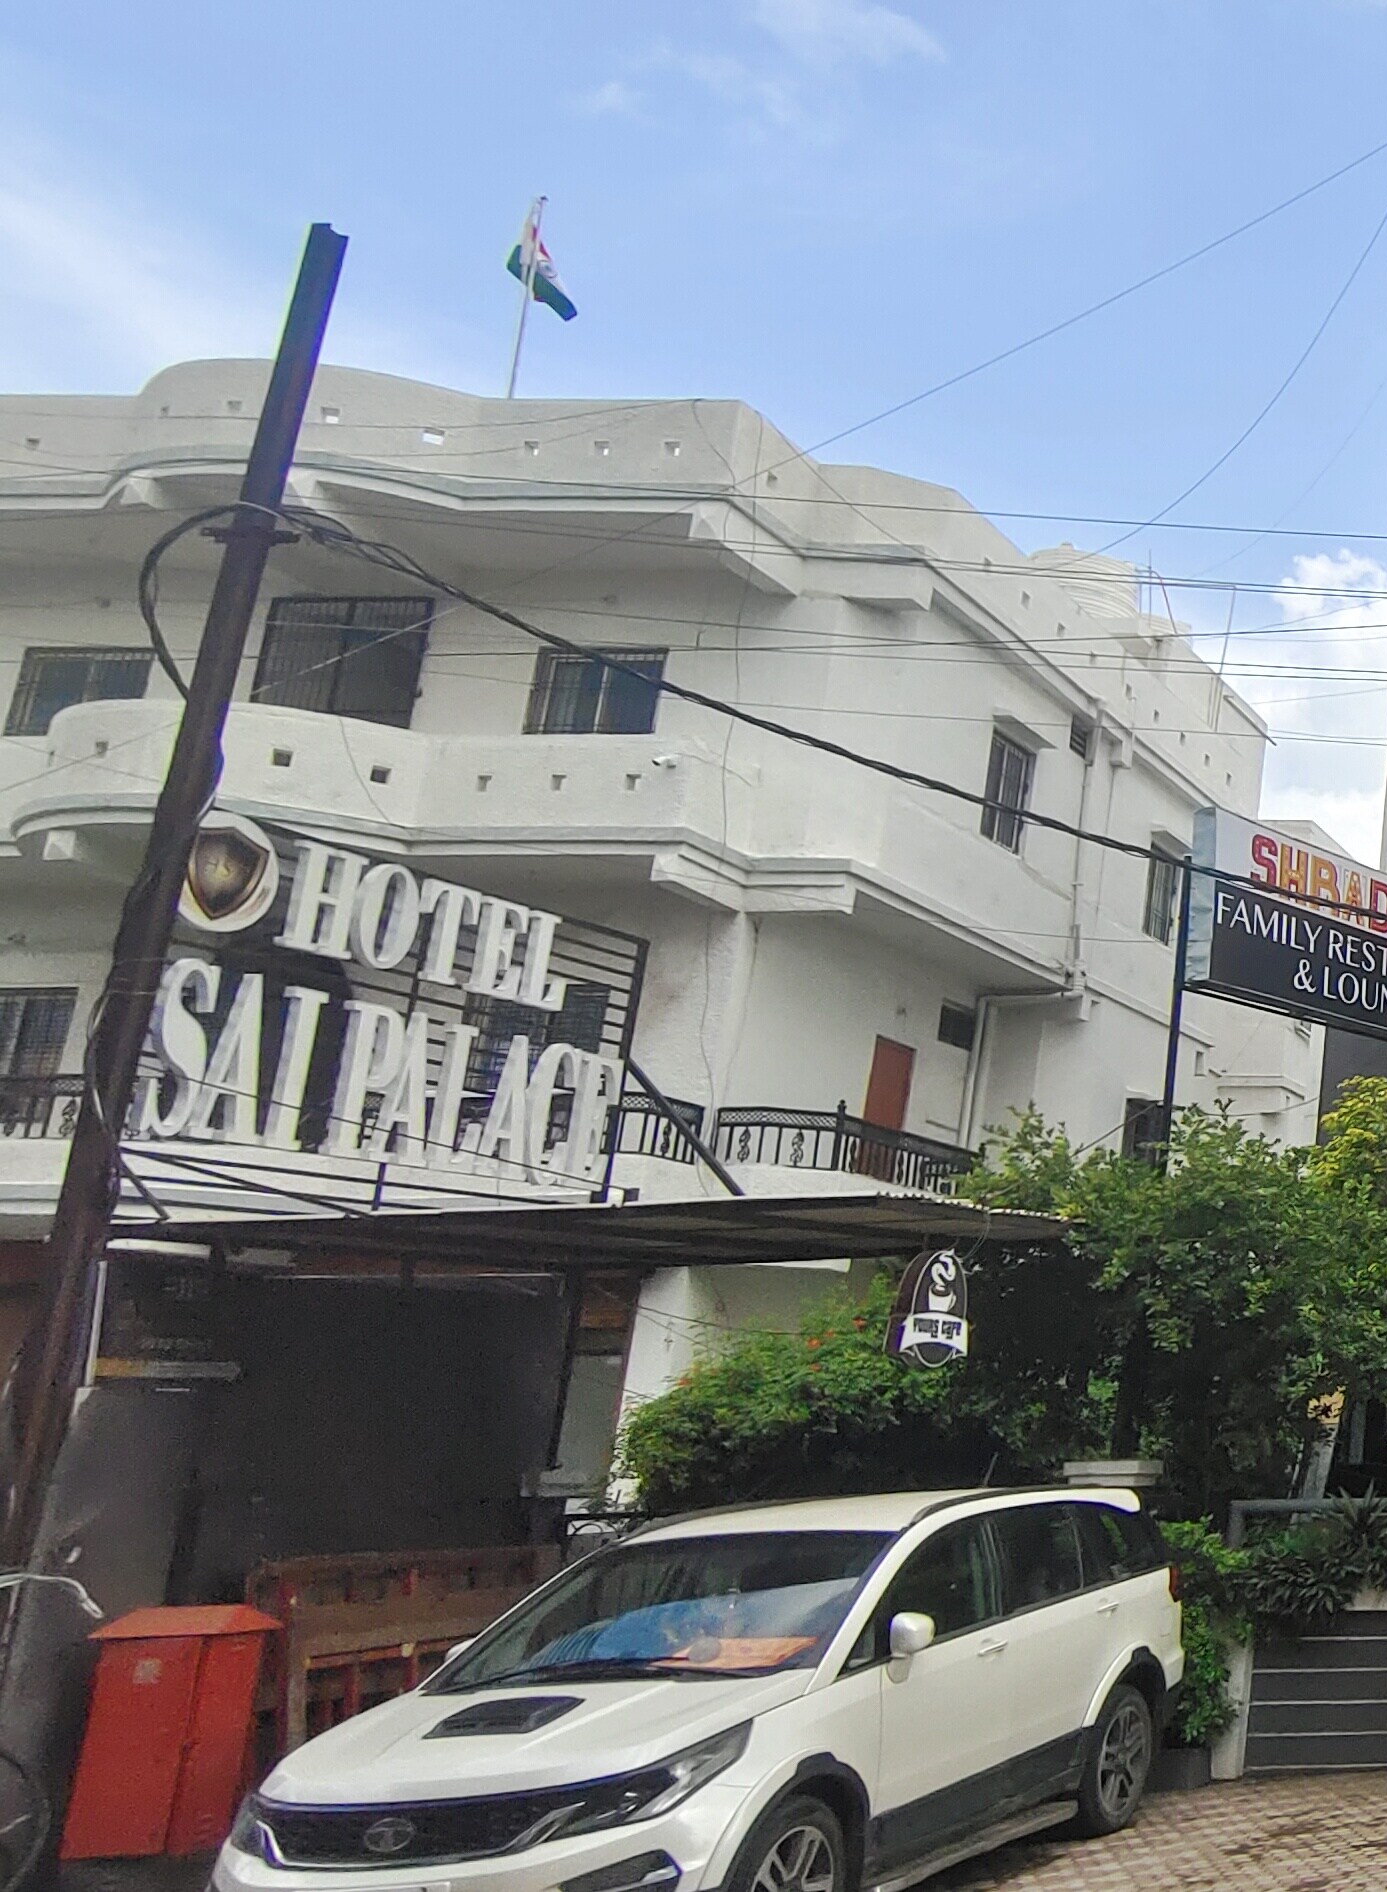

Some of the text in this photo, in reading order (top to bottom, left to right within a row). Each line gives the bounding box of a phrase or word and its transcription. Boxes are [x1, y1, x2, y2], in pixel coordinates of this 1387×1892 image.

[273, 839, 567, 1012] HOTEL
[1216, 891, 1323, 954] FAMILY
[1294, 958, 1317, 993] &
[122, 958, 624, 1191] SAI PALACE
